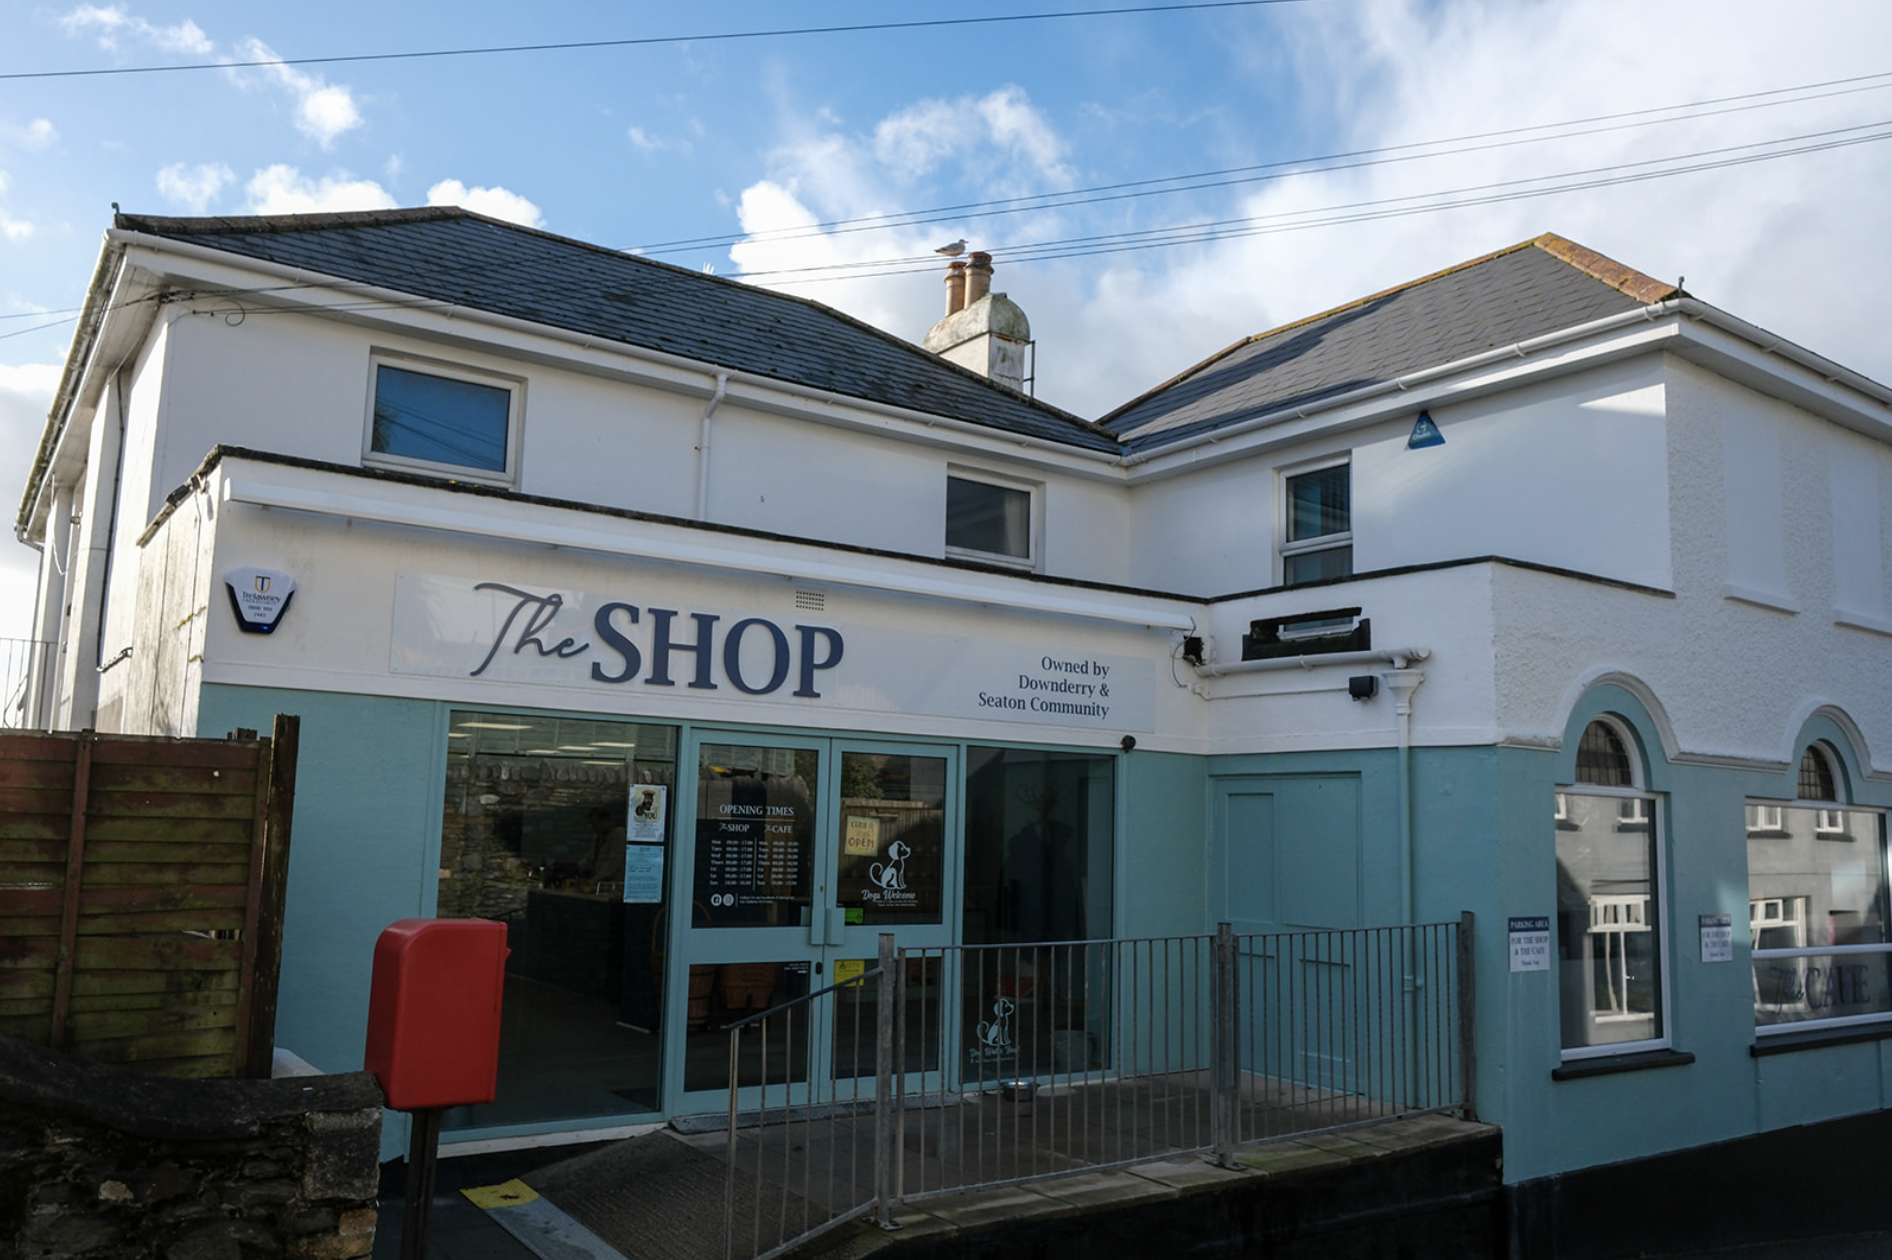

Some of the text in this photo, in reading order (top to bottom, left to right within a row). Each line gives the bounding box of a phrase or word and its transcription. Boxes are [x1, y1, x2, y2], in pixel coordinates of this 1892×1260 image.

[242, 591, 281, 602] Trelawney
[470, 582, 844, 698] The SHOP
[1041, 656, 1110, 679] Owned by
[1018, 674, 1109, 698] Downderry &
[978, 691, 1110, 720] Seaton Community
[719, 804, 794, 816] OPENING TIMES
[727, 823, 750, 832] SHOP
[772, 825, 793, 834] CAFE
[848, 836, 875, 849] OPEN
[861, 889, 917, 903] Dogs Welcome
[1510, 919, 1548, 929] PARKING AREA
[1511, 935, 1548, 945] FOR THE SHOP
[1520, 947, 1530, 955] THE
[1805, 964, 1871, 1010] CAFE
